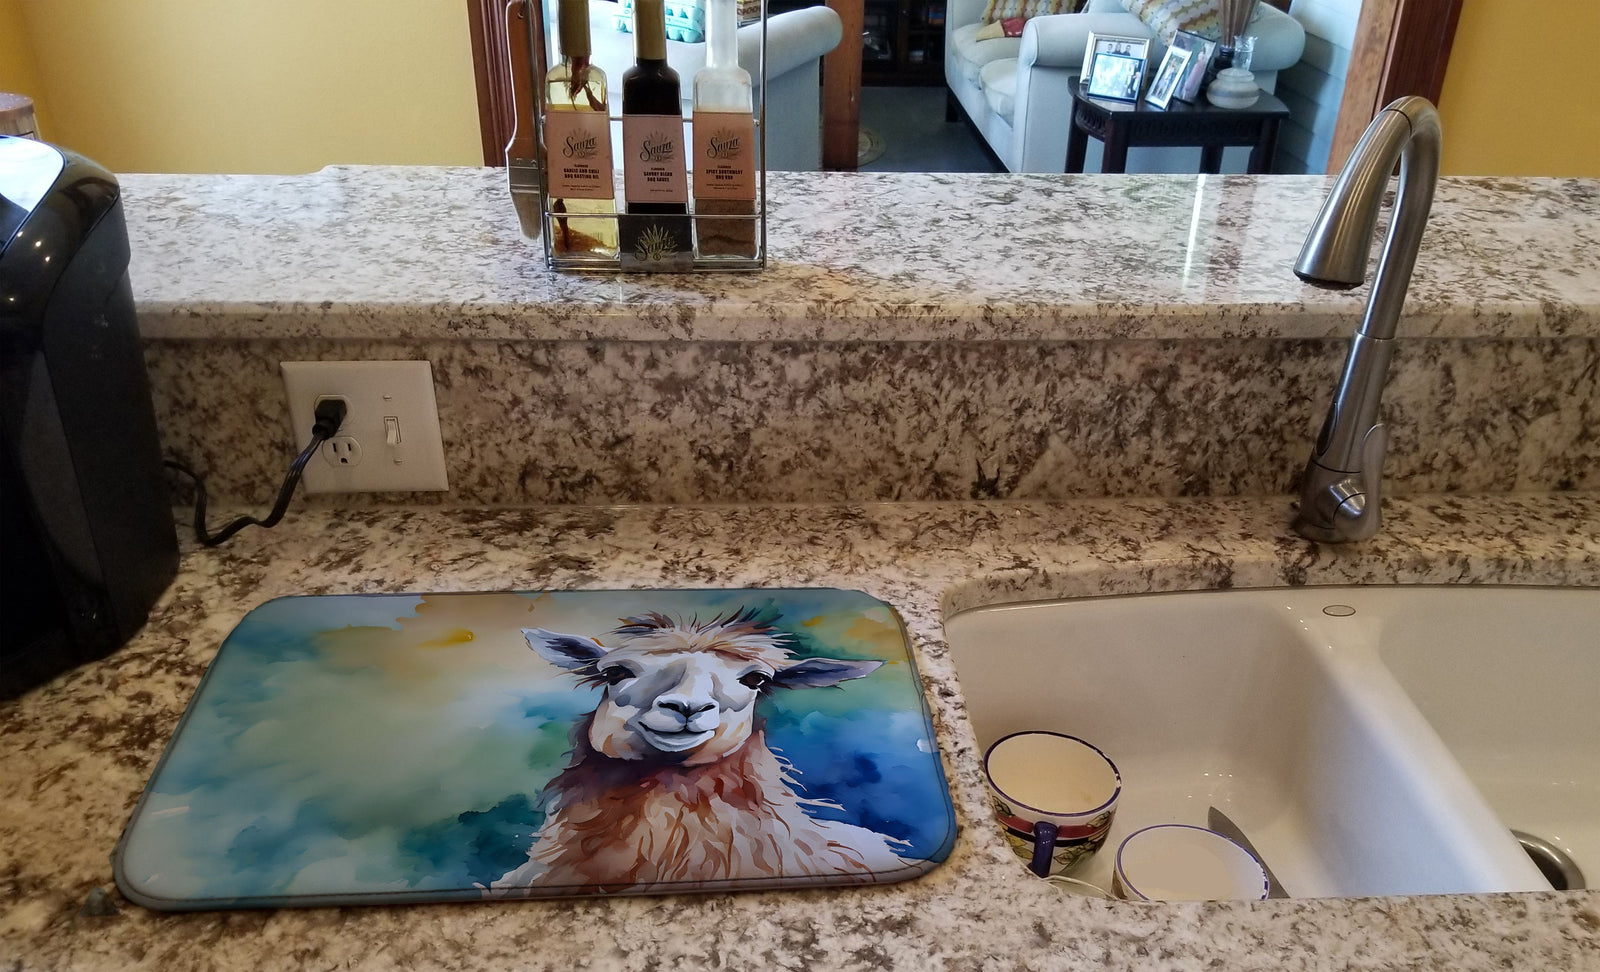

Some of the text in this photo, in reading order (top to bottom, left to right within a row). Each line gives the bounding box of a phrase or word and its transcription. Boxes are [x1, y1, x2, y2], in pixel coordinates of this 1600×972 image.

[563, 136, 597, 158] Sauza
[640, 140, 673, 162] Sauza
[707, 137, 739, 158] Sauza
